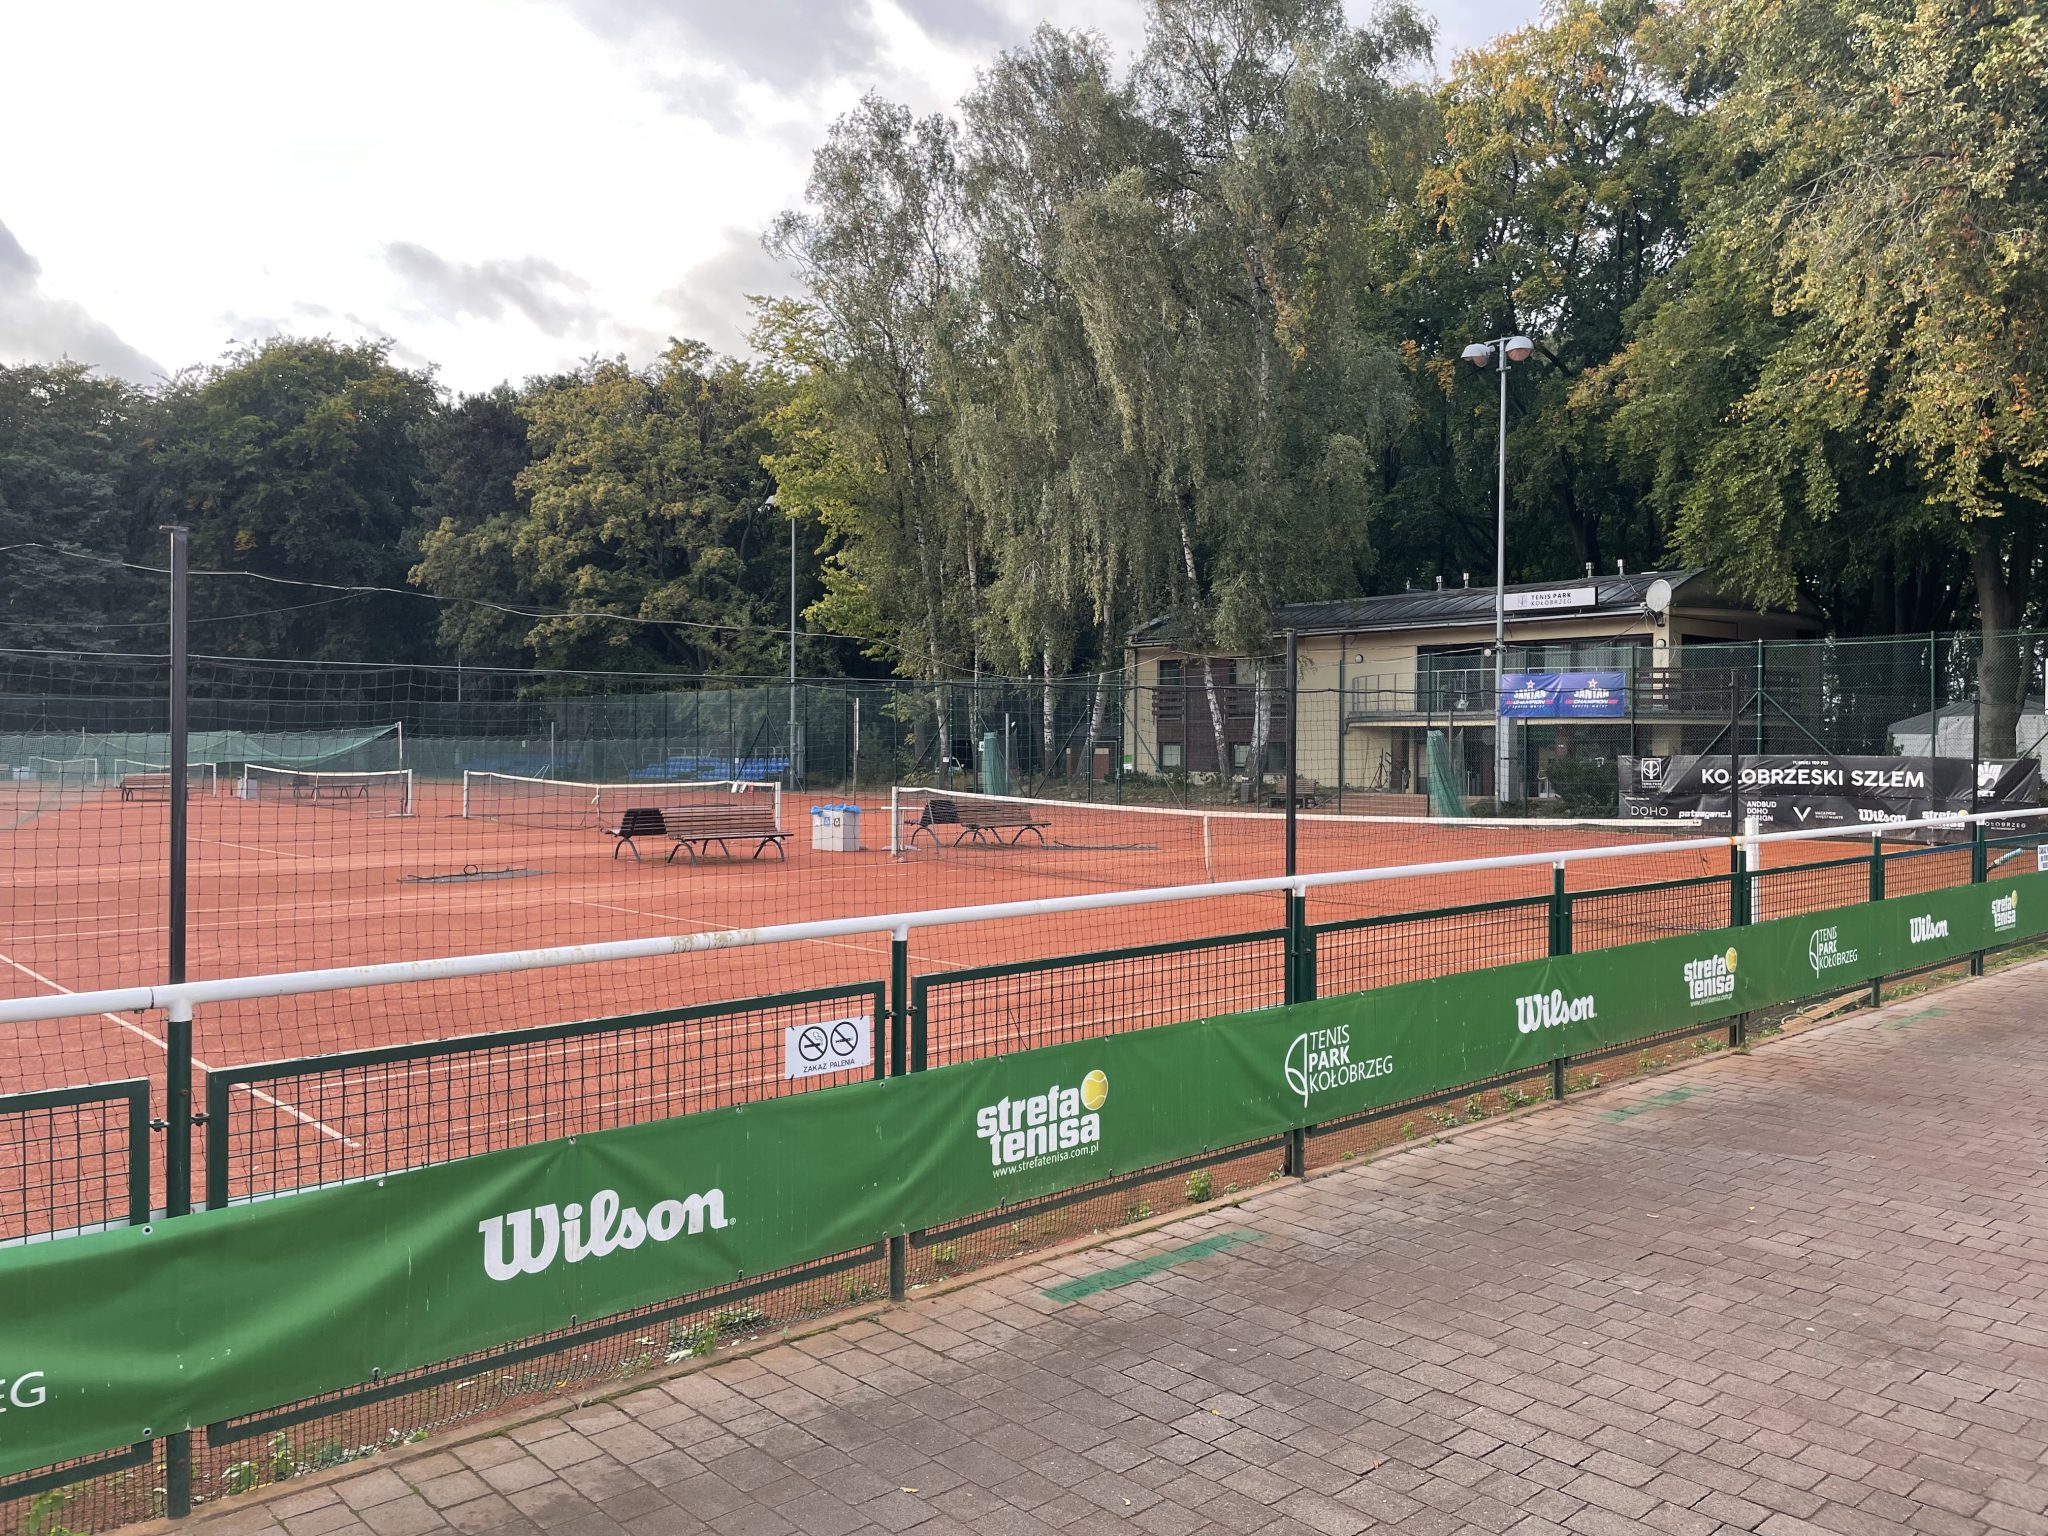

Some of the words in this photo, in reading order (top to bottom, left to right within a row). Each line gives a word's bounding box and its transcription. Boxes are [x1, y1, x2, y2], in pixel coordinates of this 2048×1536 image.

[1851, 769, 1924, 788] SZLEM
[1631, 806, 1669, 817] DOHO
[1746, 800, 1777, 808] ANDBUD
[1858, 808, 1907, 823] Wilson
[1984, 821, 2026, 829] OŁOBRZEG
[1819, 925, 1838, 942] TENIS
[1909, 914, 1949, 944] Wilson
[1818, 939, 1838, 956] PARK
[1819, 948, 1858, 970] KOŁOBRZEG
[1683, 954, 1727, 982] strefa
[1689, 973, 1735, 1000] tenisa
[1515, 988, 1597, 1034] Wilson
[1309, 1024, 1350, 1051] TENIS
[803, 1062, 828, 1073] ZAKAZ
[829, 1058, 855, 1069] PALENIA
[1308, 1045, 1351, 1073] PARK
[1309, 1055, 1393, 1094] KOŁOBRZEG
[976, 1085, 1080, 1139] strefa
[989, 1112, 1101, 1167] tenisa
[992, 1142, 1100, 1179] www.strefatenisa.com.pl
[478, 1188, 730, 1281] Wilson
